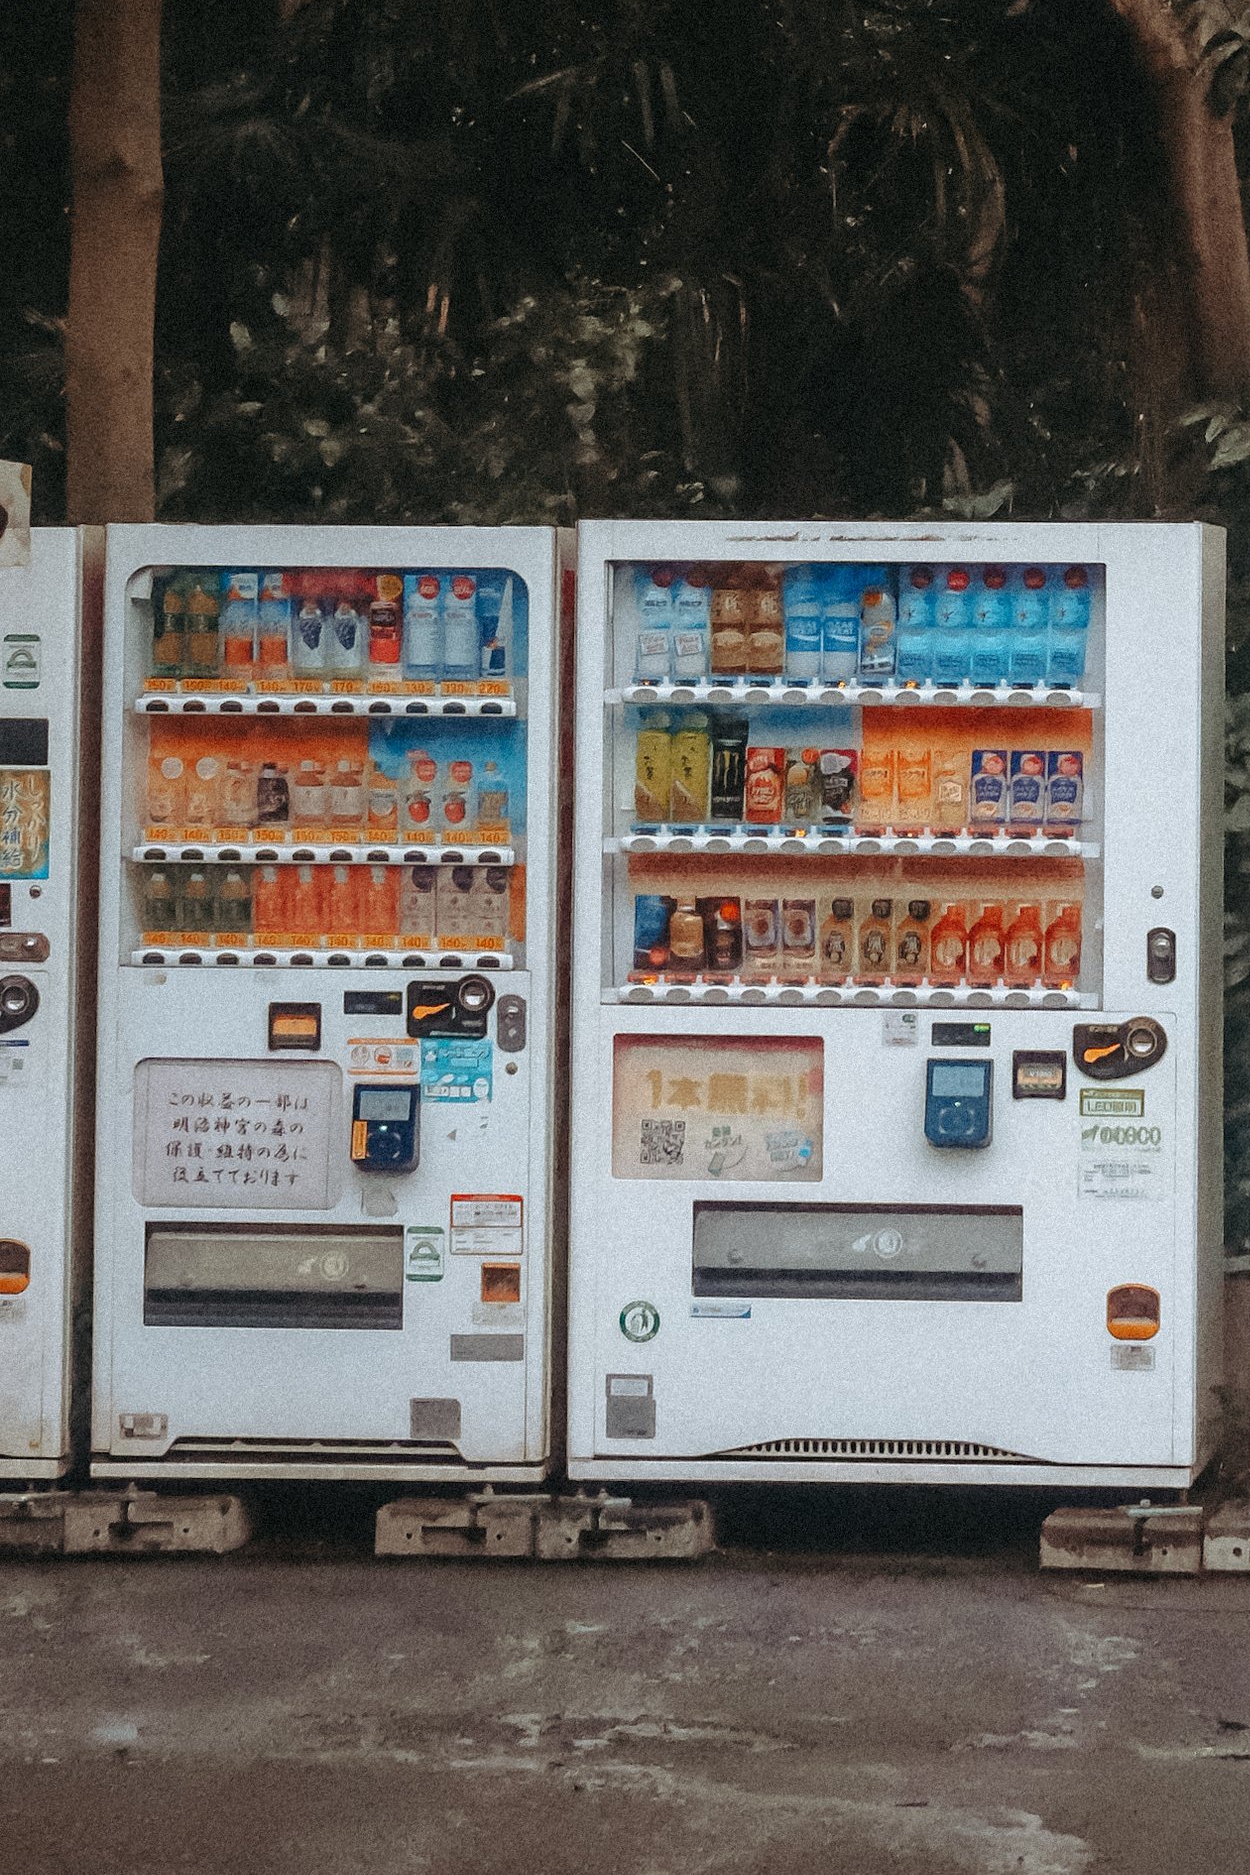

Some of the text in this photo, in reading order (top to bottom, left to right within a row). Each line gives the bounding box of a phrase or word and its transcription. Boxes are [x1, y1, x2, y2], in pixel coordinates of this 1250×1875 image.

[2, 780, 22, 867] 水分補給
[168, 1092, 309, 1110] この収益の一部は
[172, 1117, 304, 1137] 明治神宮の森の
[166, 1140, 308, 1163] 保護・維持の為に
[172, 1166, 300, 1186] 役立てております
